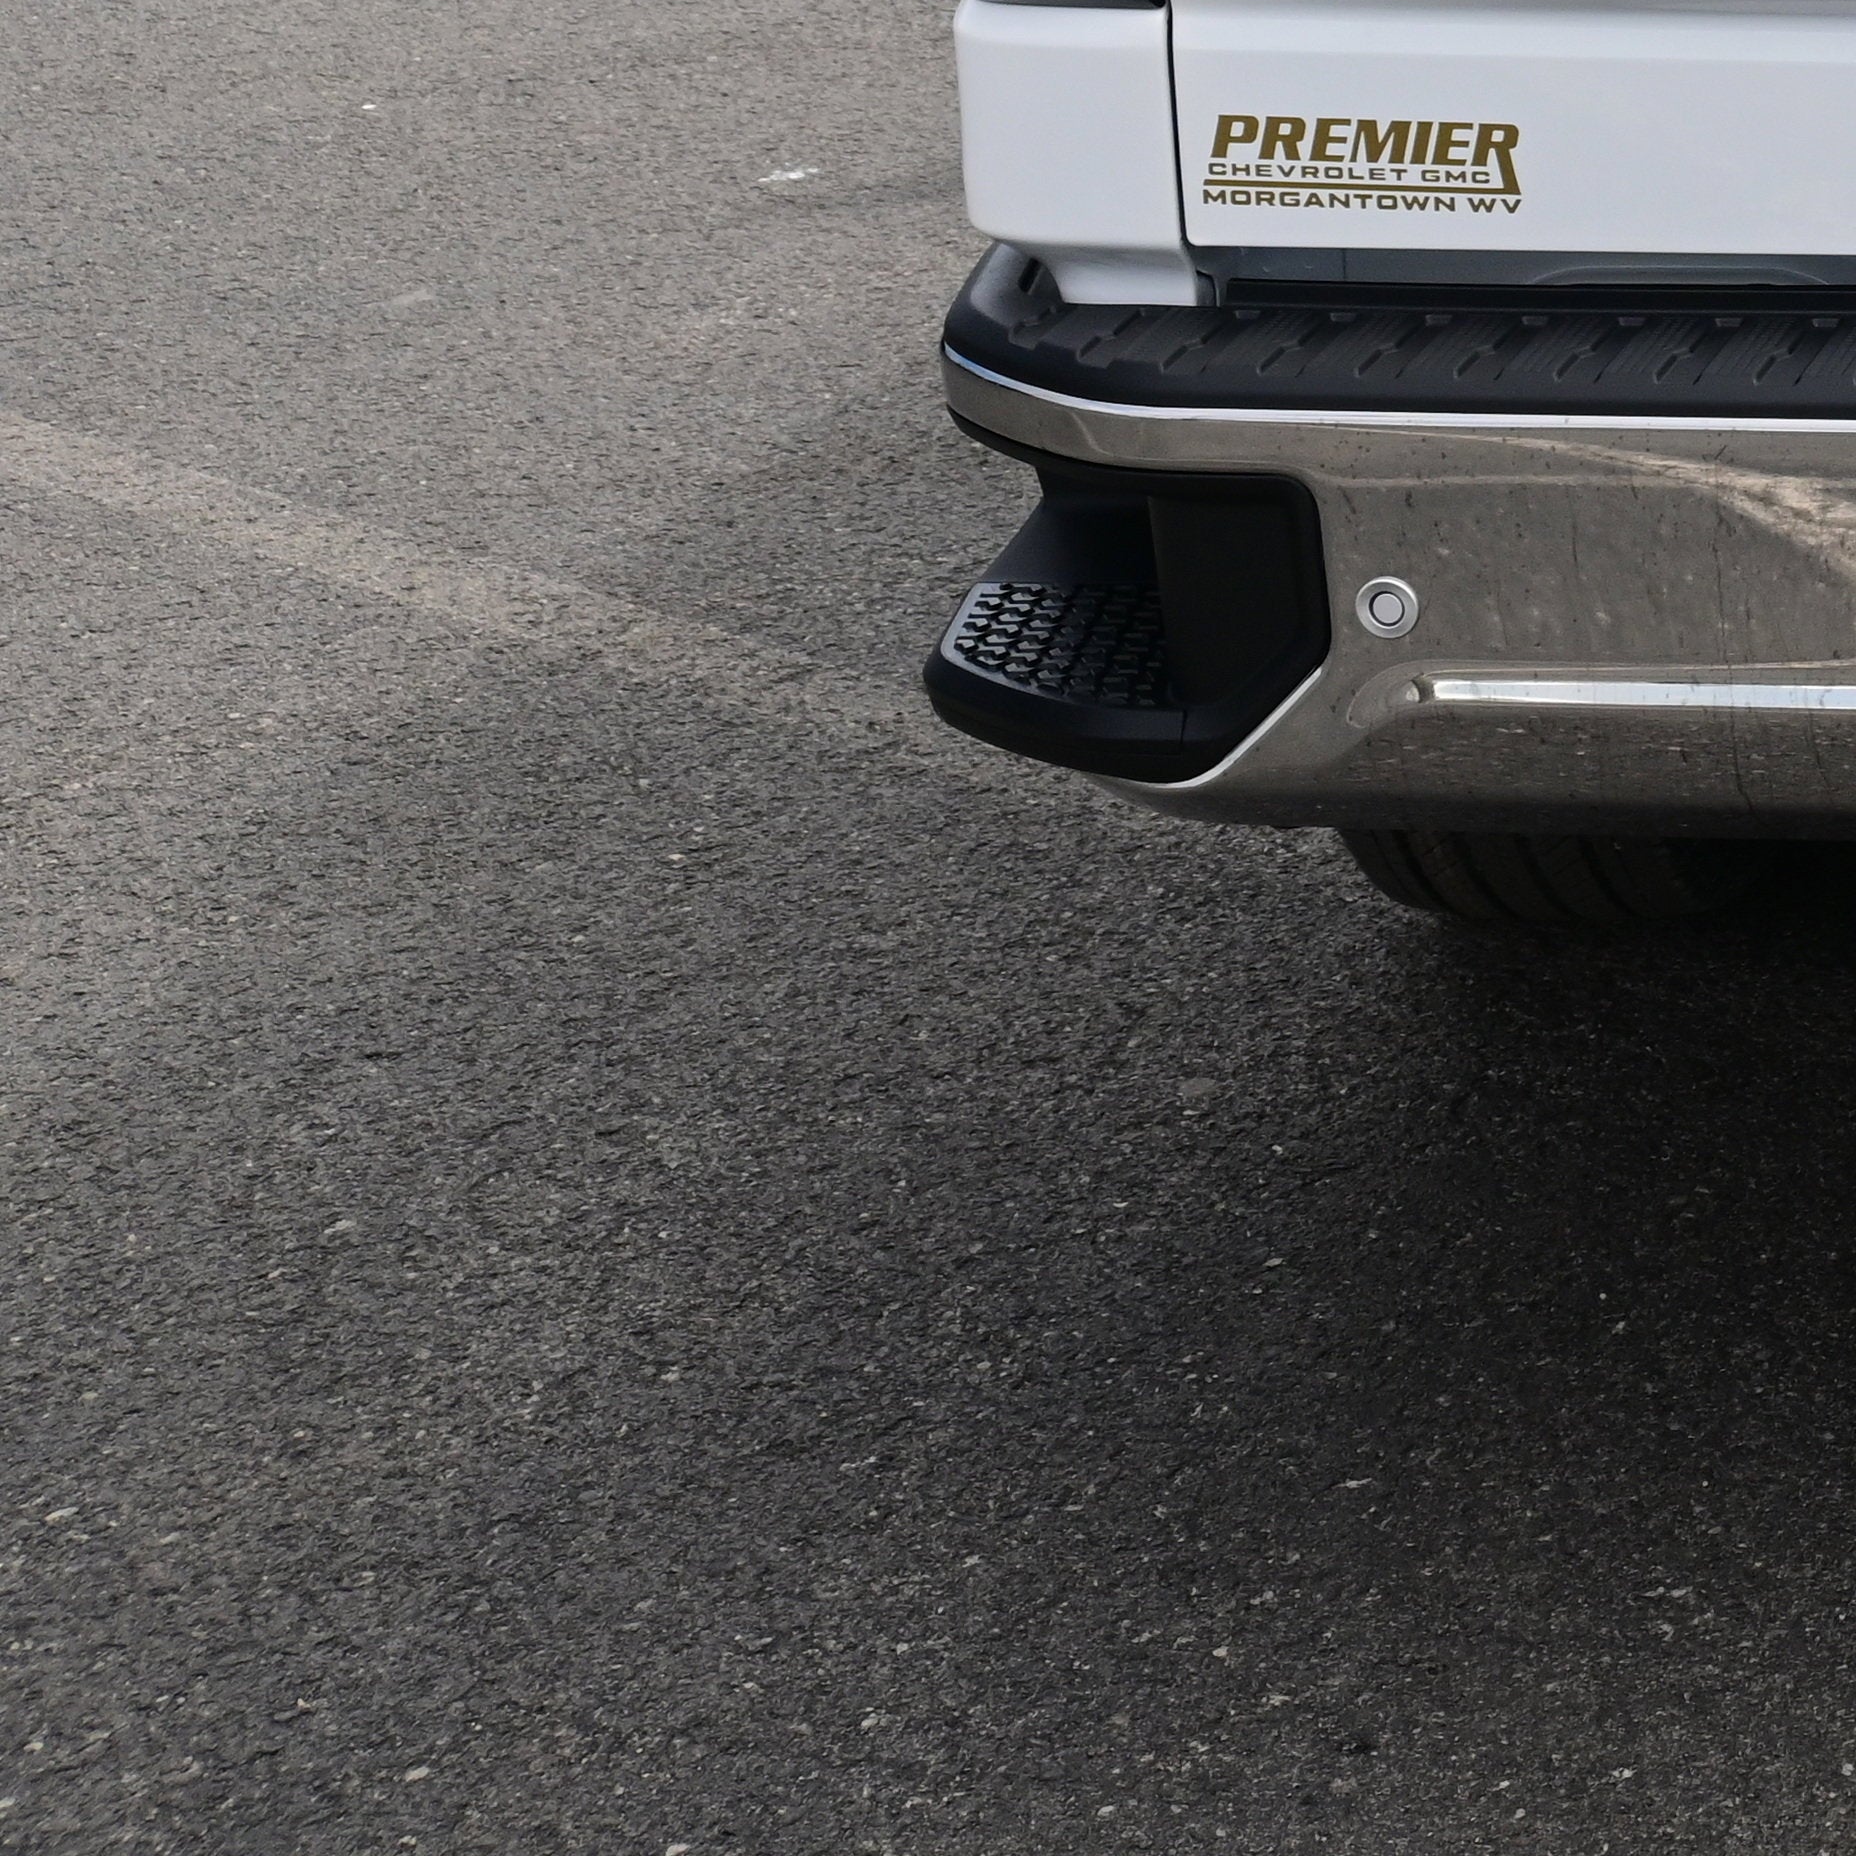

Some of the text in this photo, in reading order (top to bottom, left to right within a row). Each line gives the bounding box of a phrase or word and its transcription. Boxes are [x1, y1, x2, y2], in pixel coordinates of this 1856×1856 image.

[1210, 114, 1522, 195] PREMIER
[1208, 162, 1491, 184] CHEVROLET GMC
[1203, 189, 1522, 214] MORGANTOWN WV
